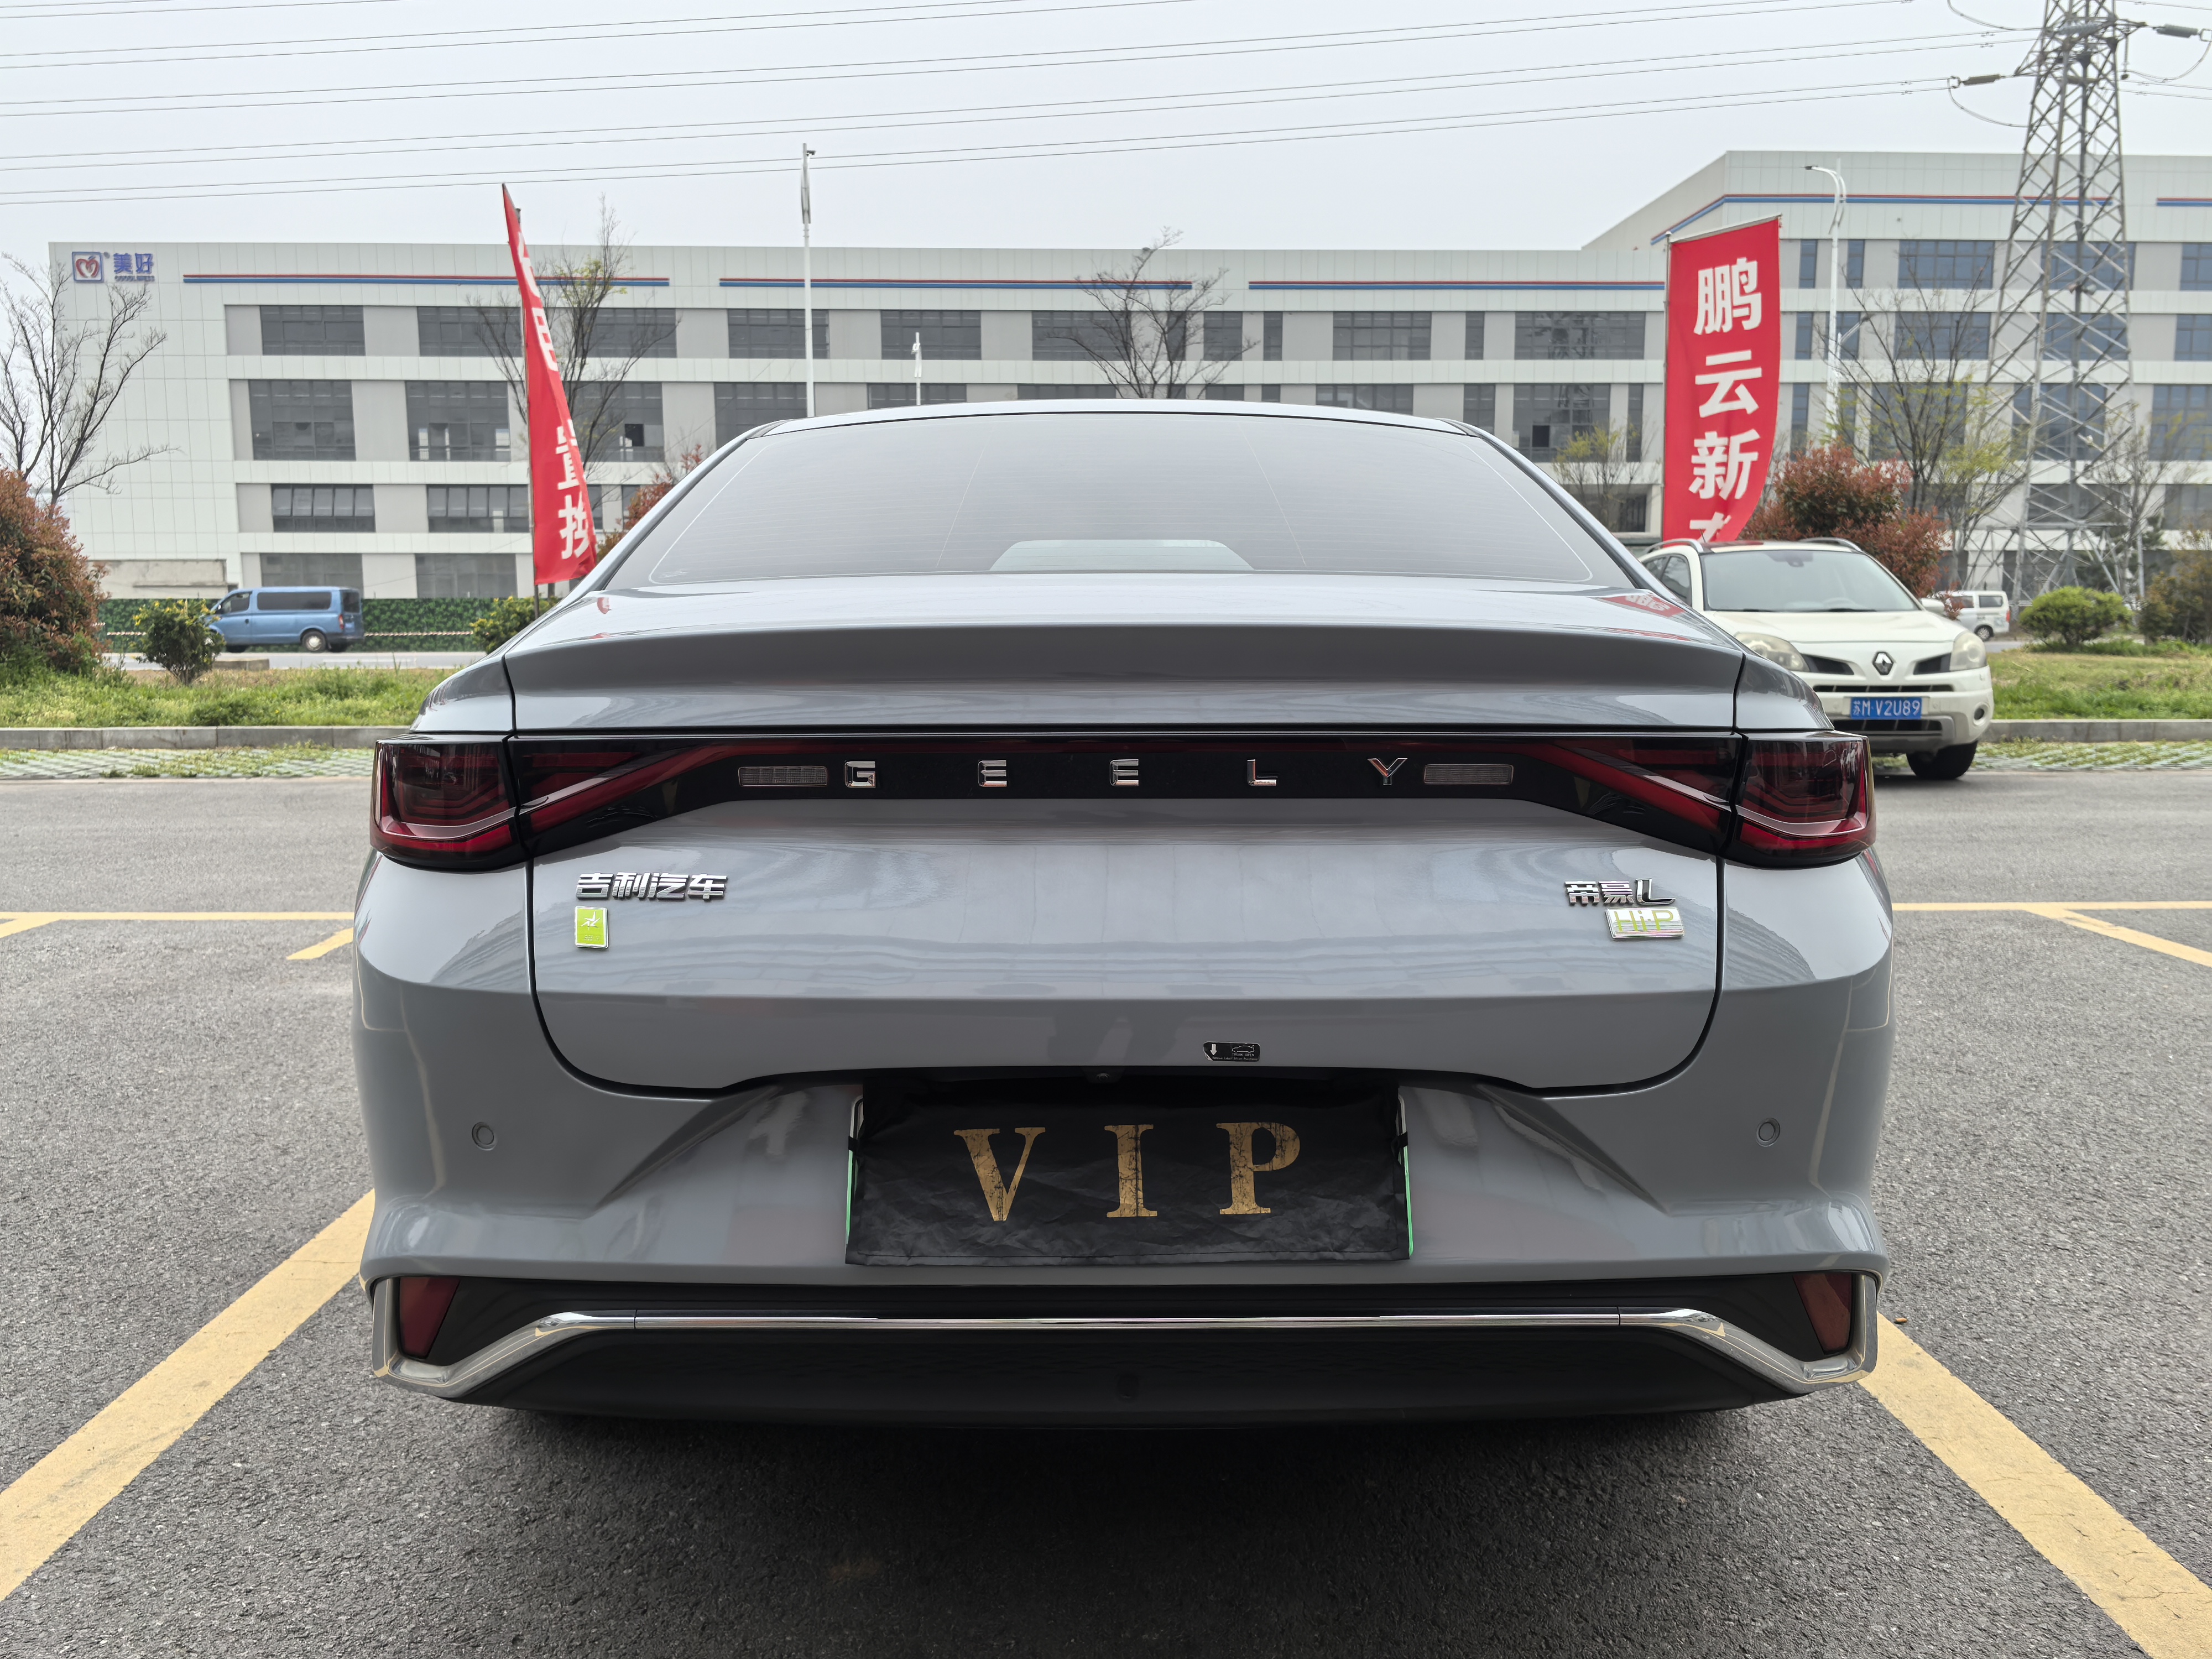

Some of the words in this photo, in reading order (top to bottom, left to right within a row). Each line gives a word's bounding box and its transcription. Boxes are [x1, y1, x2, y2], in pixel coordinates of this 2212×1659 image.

[113, 253, 154, 274] 美好
[844, 759, 1408, 789] GEELY
[576, 872, 728, 901] 吉利汽车
[953, 1121, 1301, 1221] VIP
